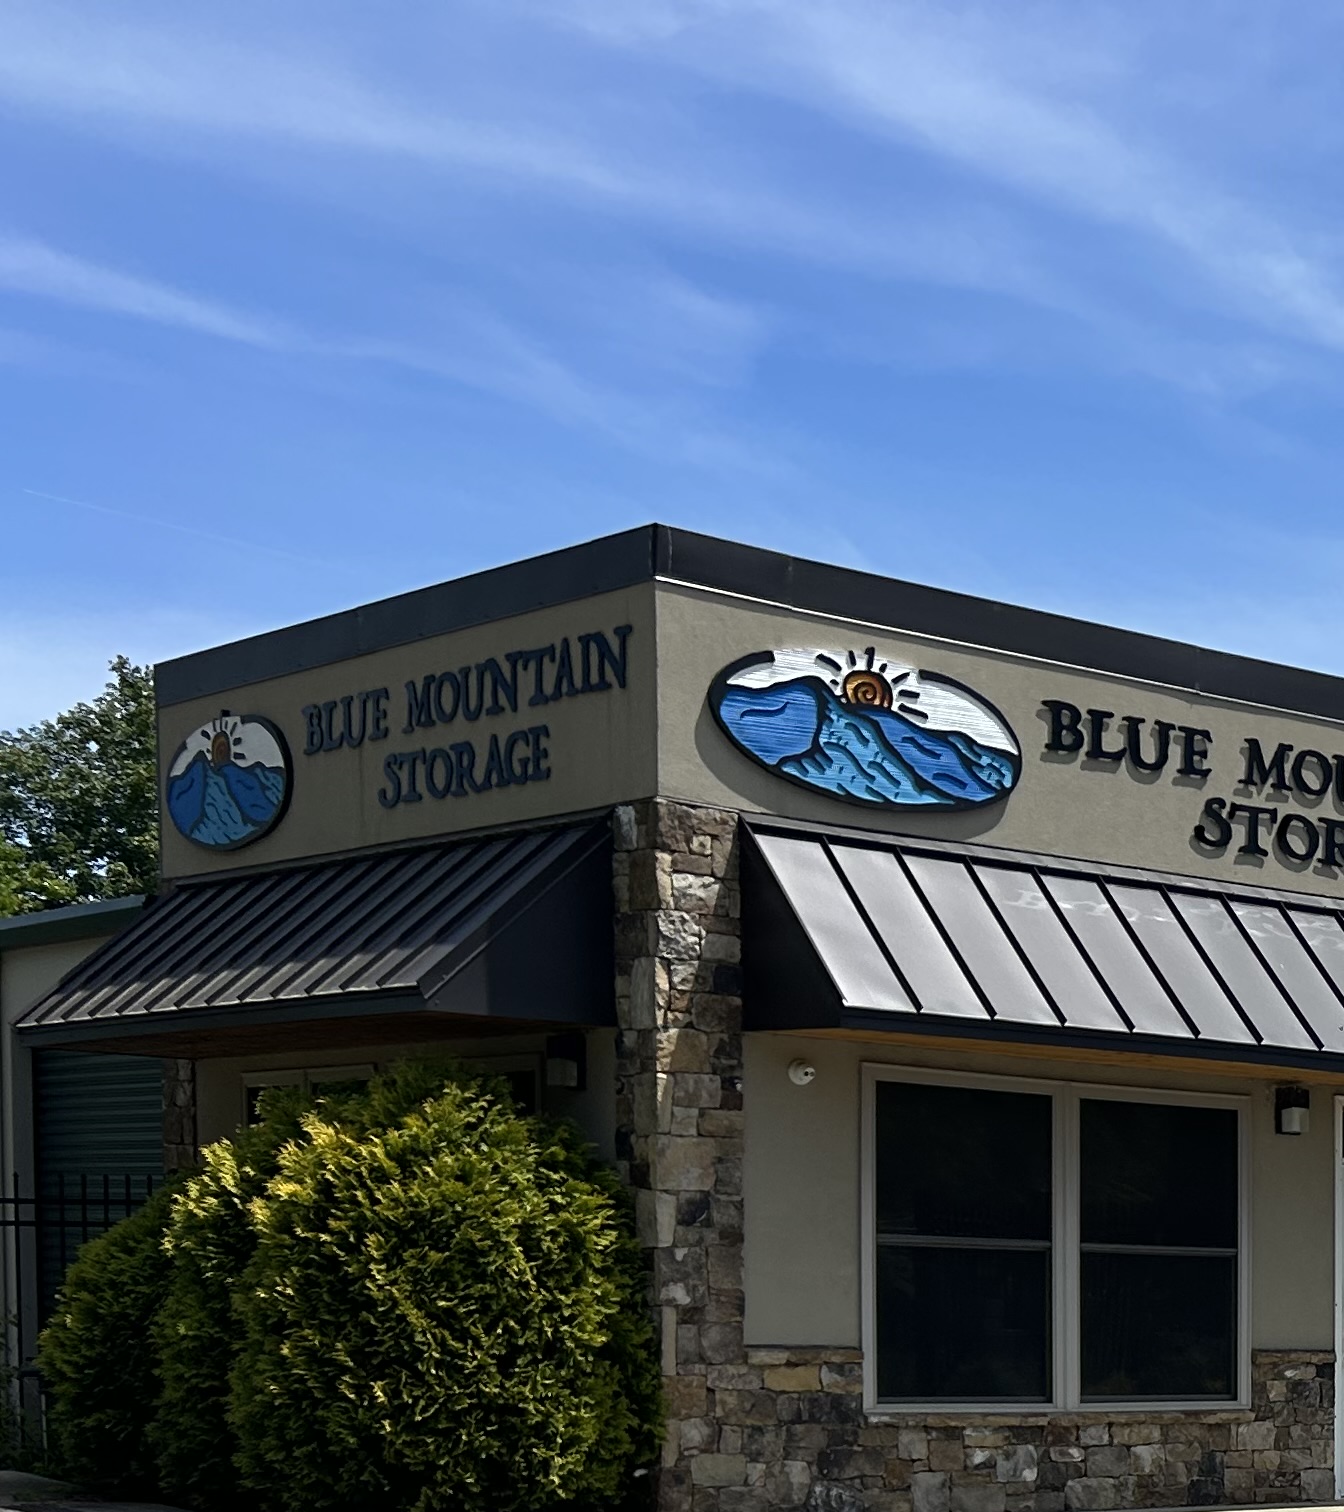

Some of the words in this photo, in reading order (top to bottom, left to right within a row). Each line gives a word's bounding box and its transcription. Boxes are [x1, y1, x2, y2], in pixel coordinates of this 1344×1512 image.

[303, 687, 389, 755] BLUE
[402, 624, 633, 734] MOUNTAIN
[378, 724, 551, 809] STORAGE
[1042, 699, 1213, 778] BLUE
